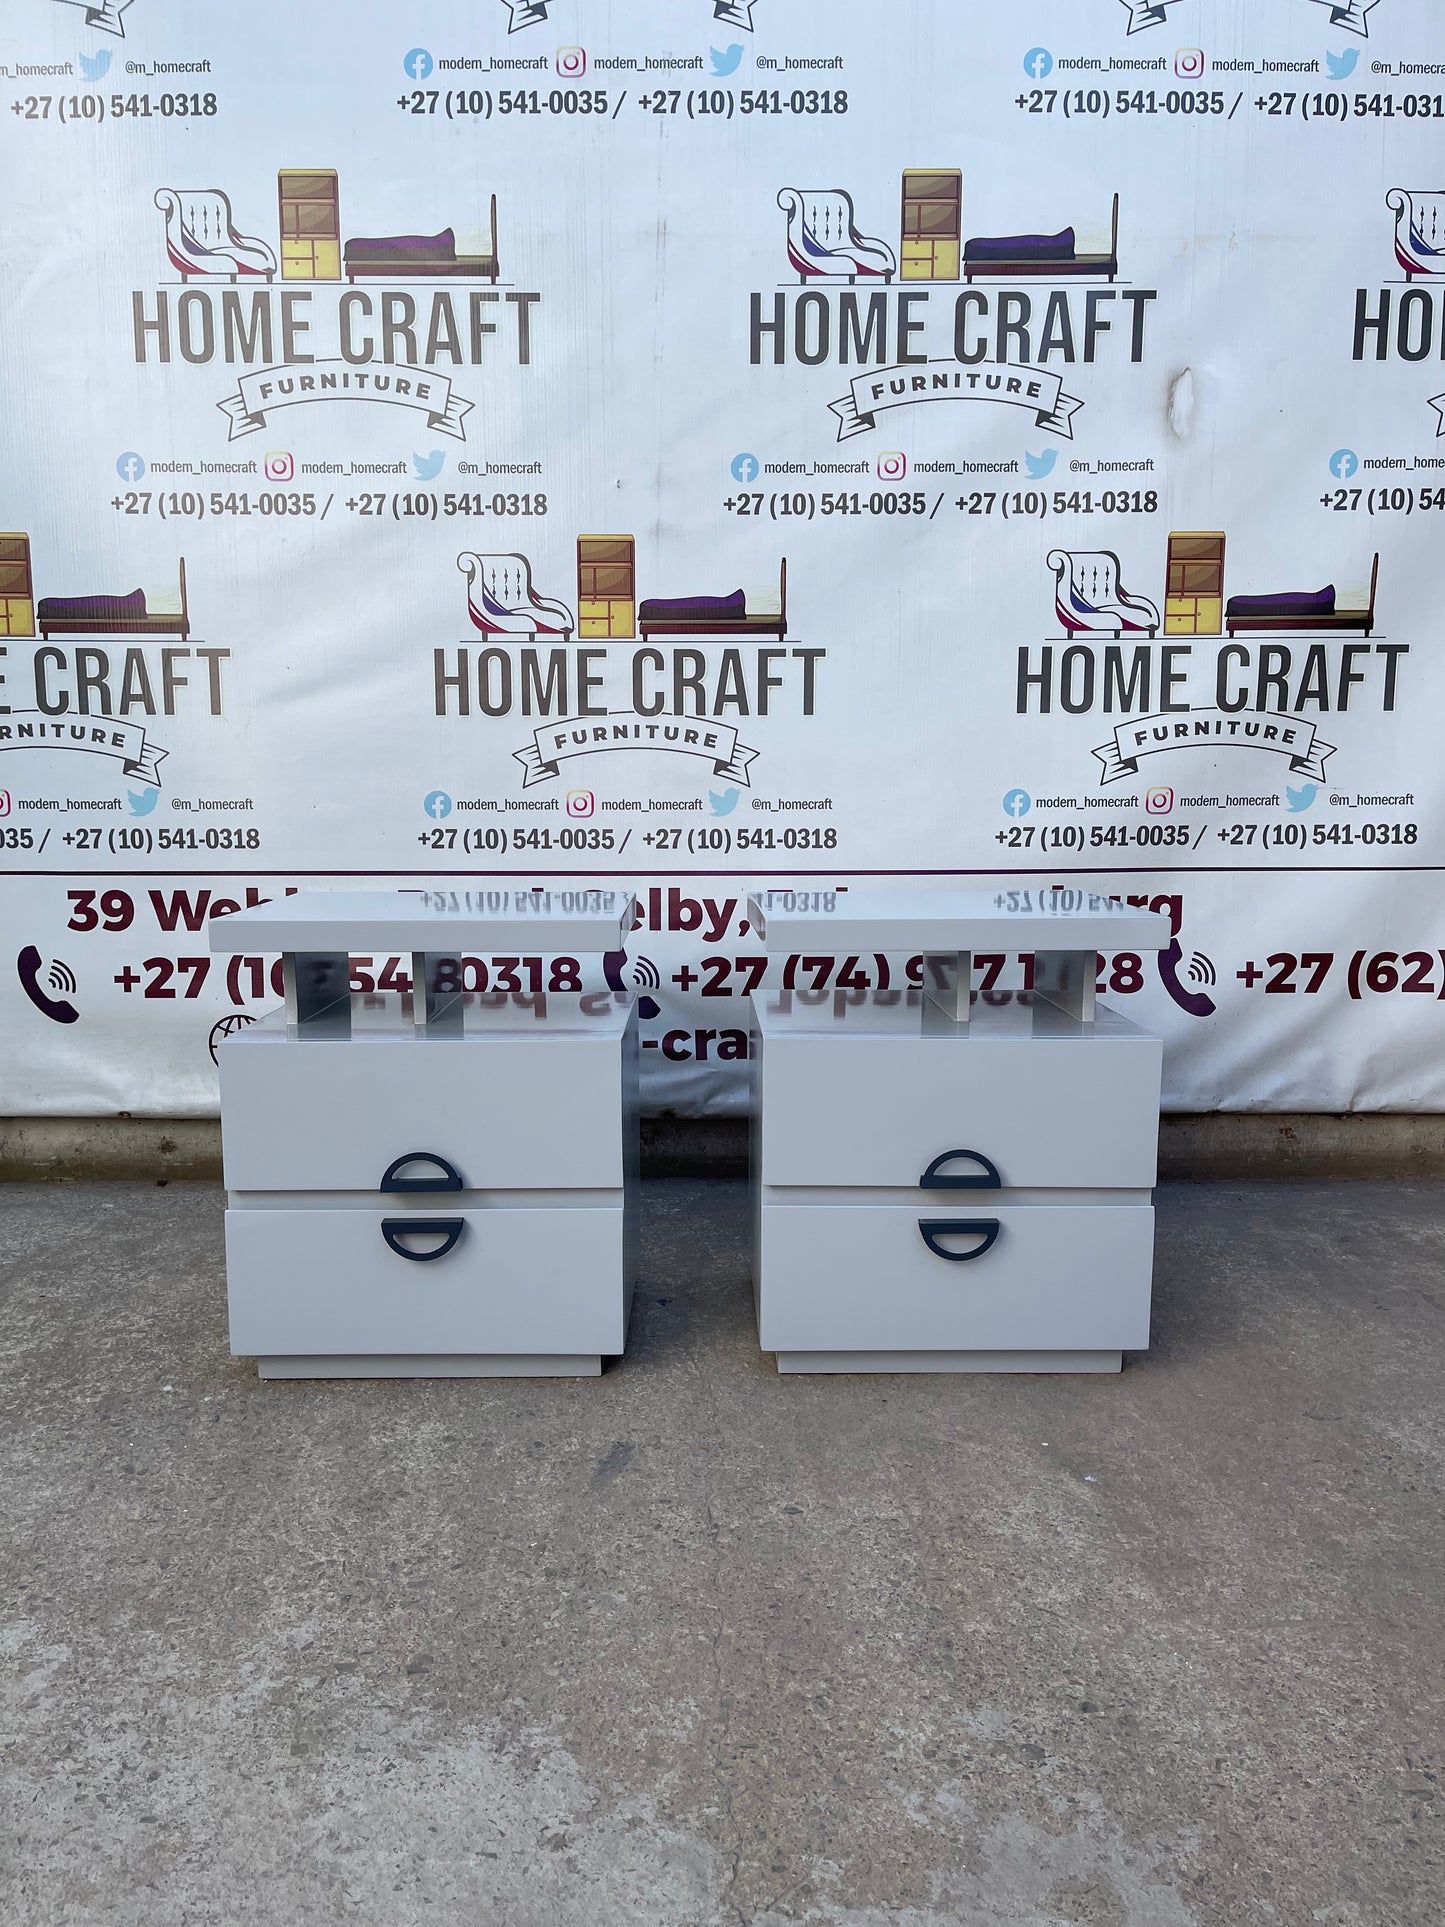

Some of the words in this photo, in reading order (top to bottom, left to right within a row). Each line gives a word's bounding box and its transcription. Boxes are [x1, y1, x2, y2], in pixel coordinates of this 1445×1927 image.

[125, 59, 211, 76] @m_homecraft
[757, 56, 843, 71] @m_homecraft
[111, 93, 217, 117] 541-0318
[740, 90, 848, 114] 541-0318
[132, 290, 315, 365] HOME
[337, 291, 540, 365] CRAFT
[750, 291, 929, 364] HOME
[953, 290, 1157, 363] CRAFT
[1353, 289, 1445, 361] HO
[259, 373, 433, 399] FURNITURE
[871, 372, 1043, 399] FURNITURE
[458, 461, 542, 476] @m_homecraft
[1070, 459, 1154, 474] @m_homecraft
[444, 493, 547, 516] 541-0318
[1053, 491, 1157, 513] 541-0318
[34, 647, 230, 716] CRAFT
[434, 648, 607, 716] HOME
[631, 648, 826, 716] CRAFT
[1017, 645, 1191, 714] HOME
[1215, 644, 1409, 712] CRAFT
[555, 724, 717, 750] FURNITURE
[1135, 720, 1296, 745] FURNITURE
[172, 798, 254, 812] @m_homecraft
[752, 798, 832, 812] @m_homecraft
[1330, 794, 1414, 807] @m_homecraft
[0, 828, 33, 849] 35
[158, 828, 260, 849] 541-0318
[737, 828, 837, 849] 541-0318
[1312, 824, 1417, 845] 541-0318
[67, 890, 134, 932] 39
[114, 957, 211, 998] +27
[671, 957, 768, 997] +27
[783, 954, 890, 991] (74)
[1236, 953, 1334, 994] +27
